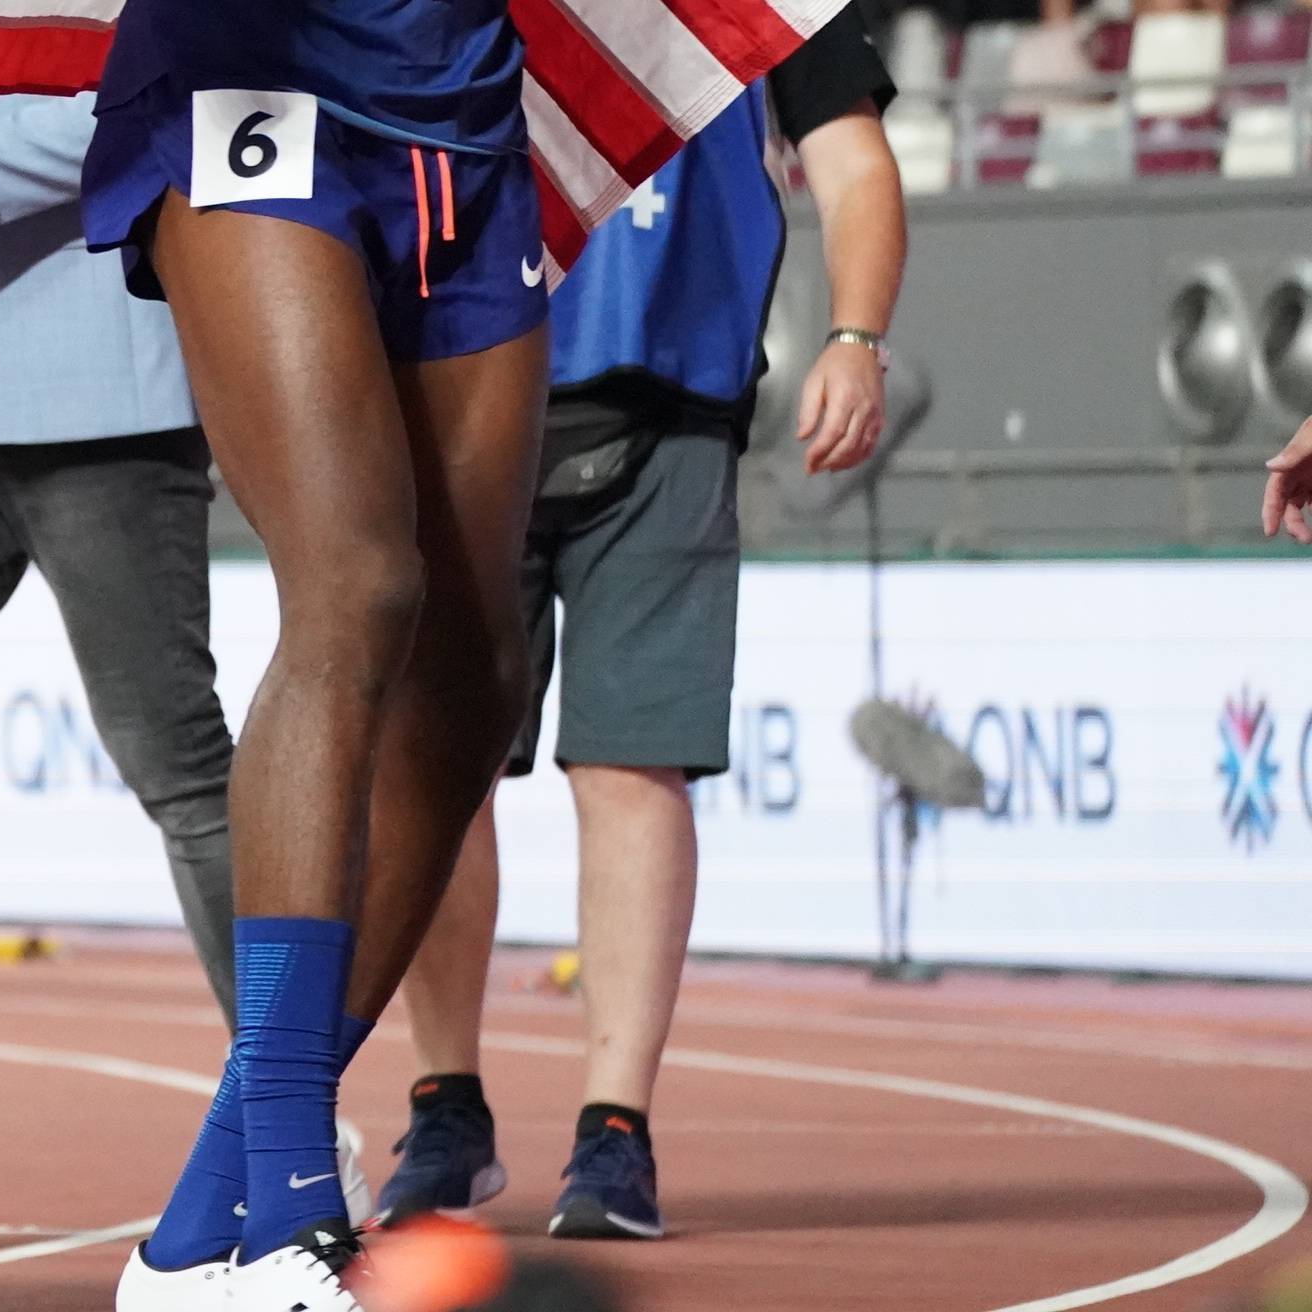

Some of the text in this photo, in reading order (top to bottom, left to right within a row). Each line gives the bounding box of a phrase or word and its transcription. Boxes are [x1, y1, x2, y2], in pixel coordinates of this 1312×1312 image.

[228, 110, 278, 179] 6
[1, 689, 132, 794] QN
[970, 702, 1116, 823] QNB
